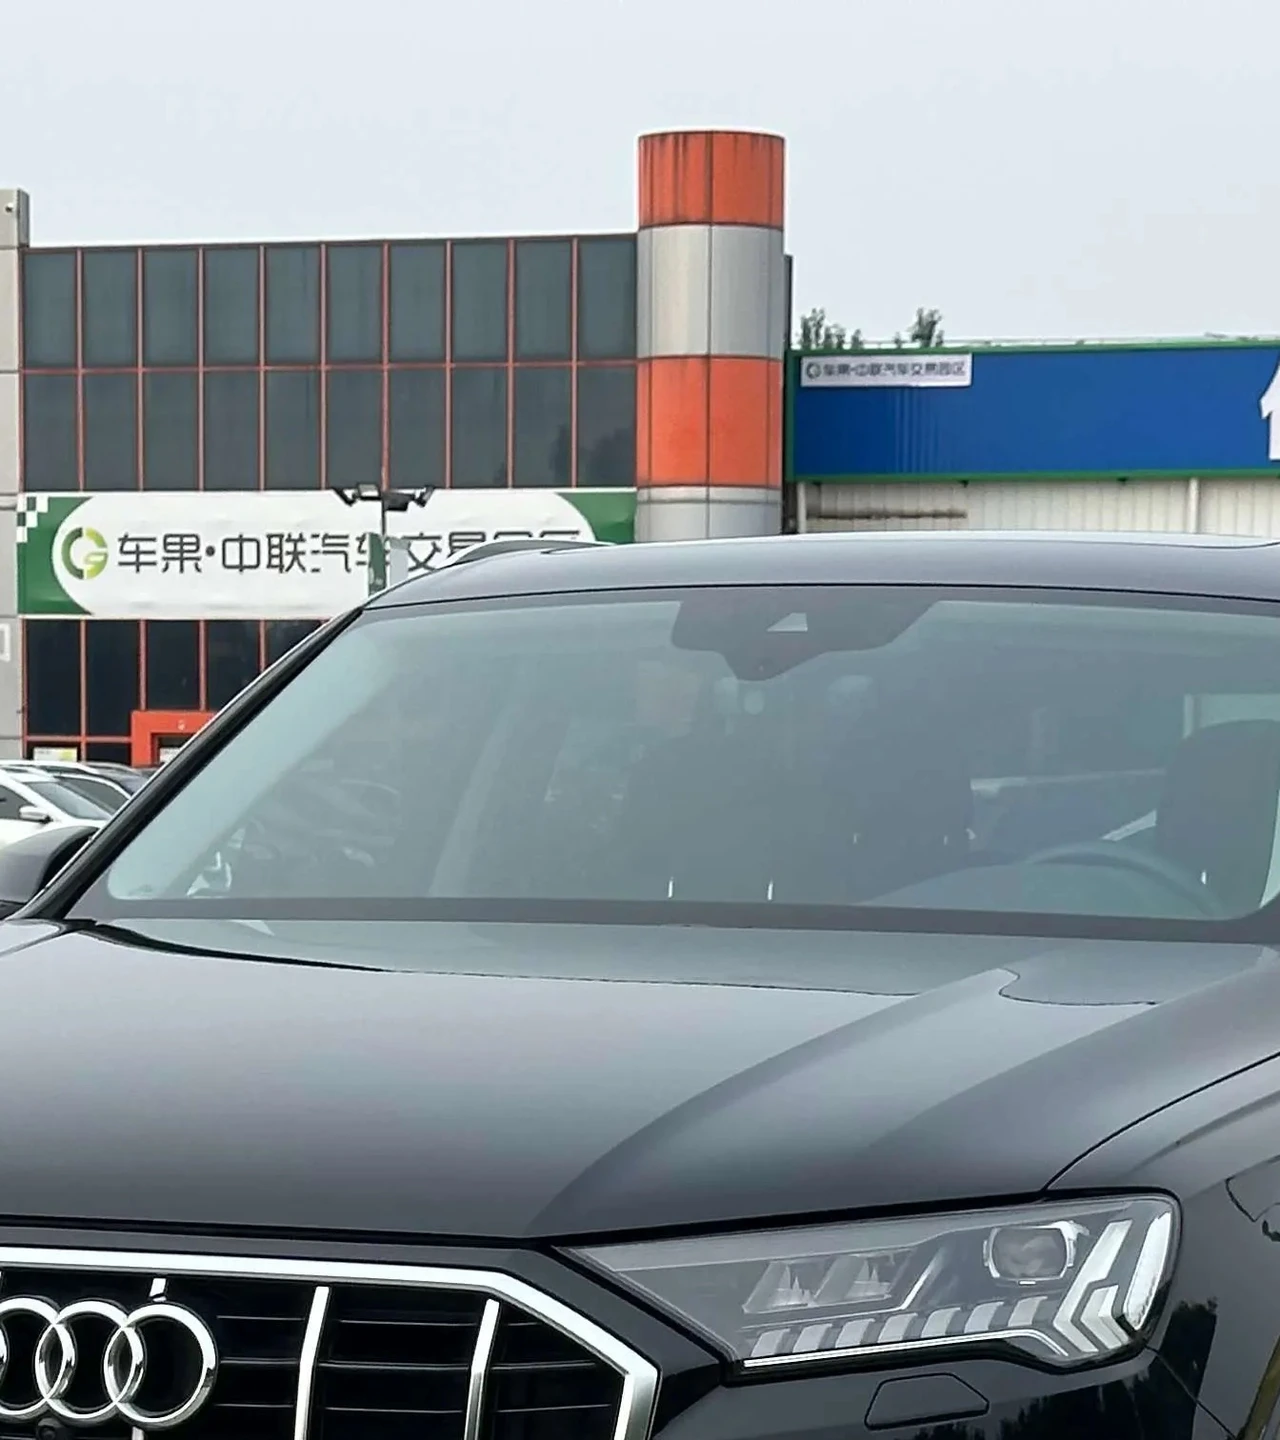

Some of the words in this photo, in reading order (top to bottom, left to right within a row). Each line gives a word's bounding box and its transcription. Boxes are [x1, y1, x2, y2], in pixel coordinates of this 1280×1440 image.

[118, 530, 581, 574] 车果·中联汽交
